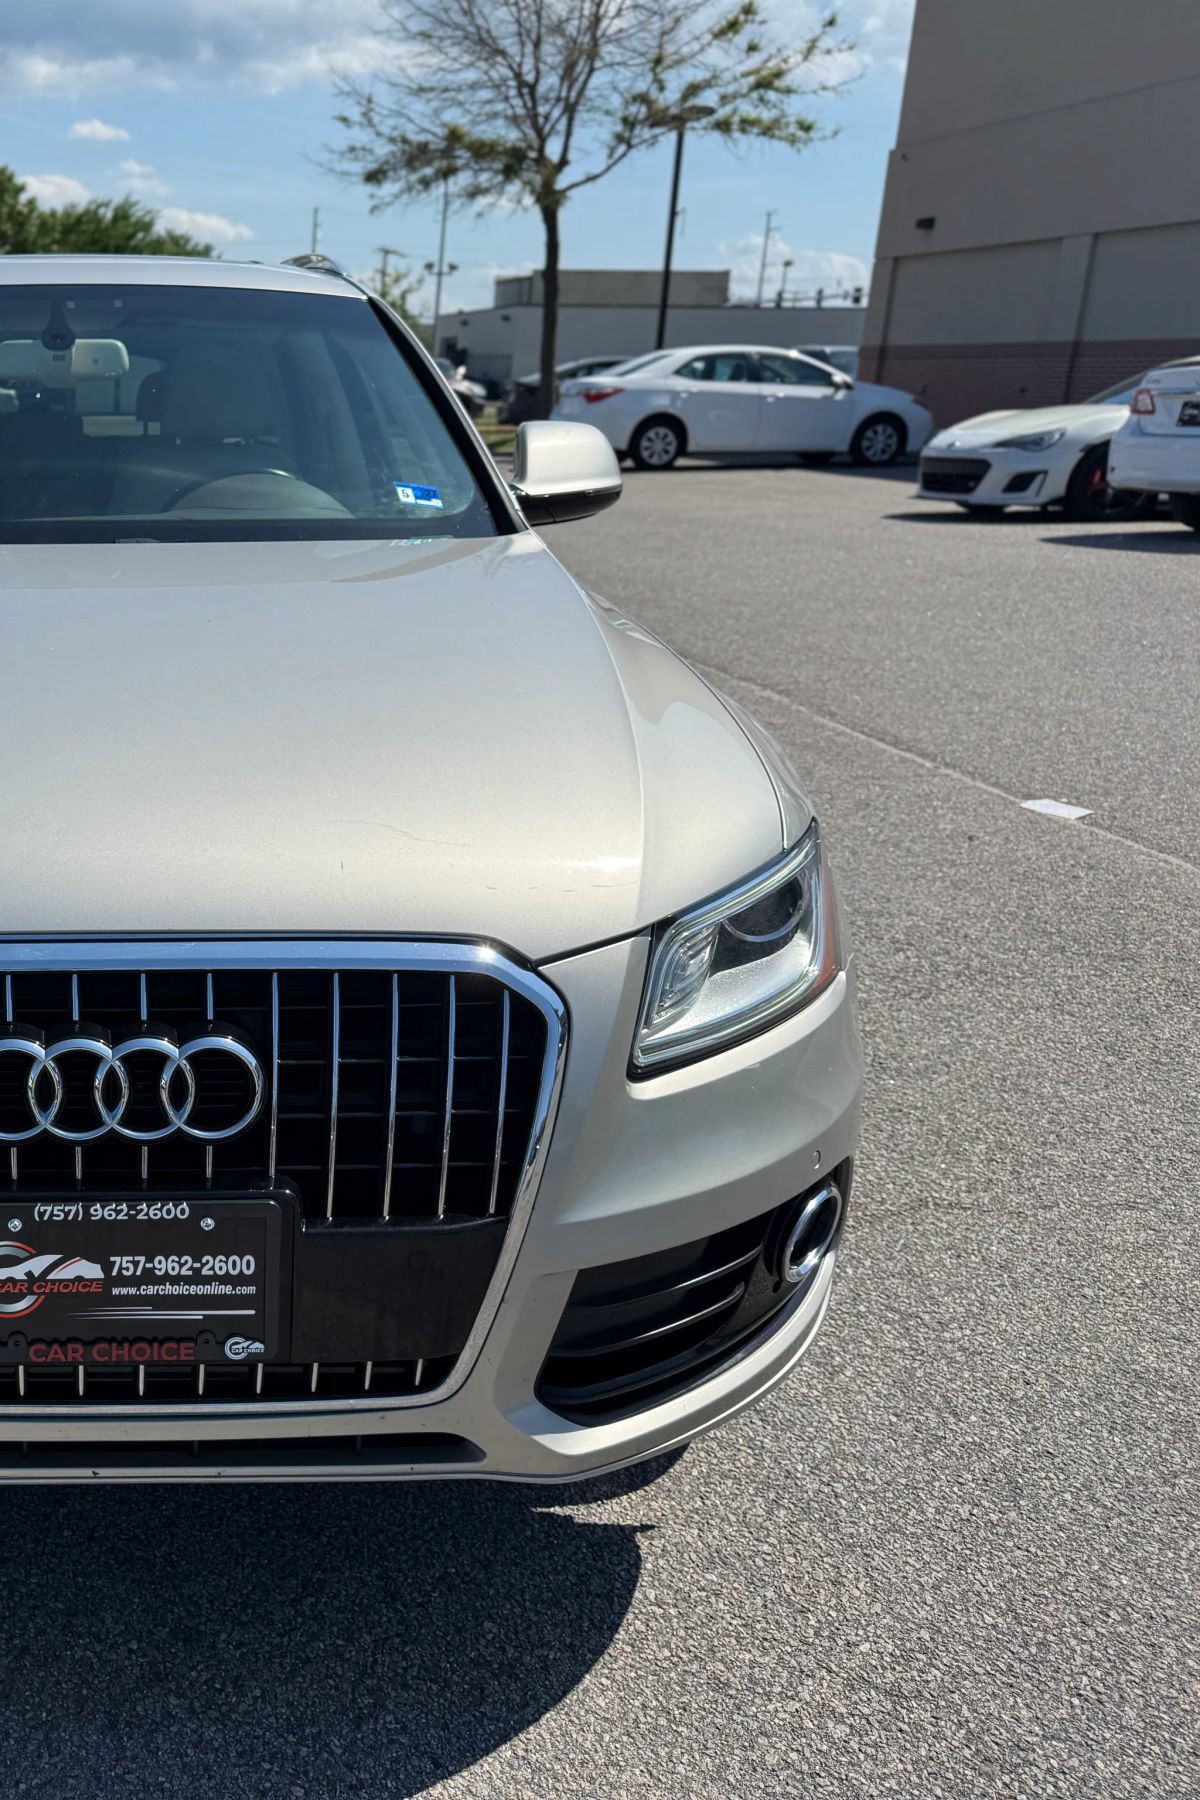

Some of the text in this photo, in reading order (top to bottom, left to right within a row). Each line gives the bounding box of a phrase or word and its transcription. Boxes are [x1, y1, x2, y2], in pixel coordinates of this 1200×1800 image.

[34, 1203, 190, 1222] (757) 962-2600
[110, 1255, 256, 1277] 757-962-2600
[33, 1281, 104, 1294] CHOICE
[112, 1281, 257, 1296] www.carchoiceonline.com
[29, 1342, 195, 1363] CAR CHOICE
